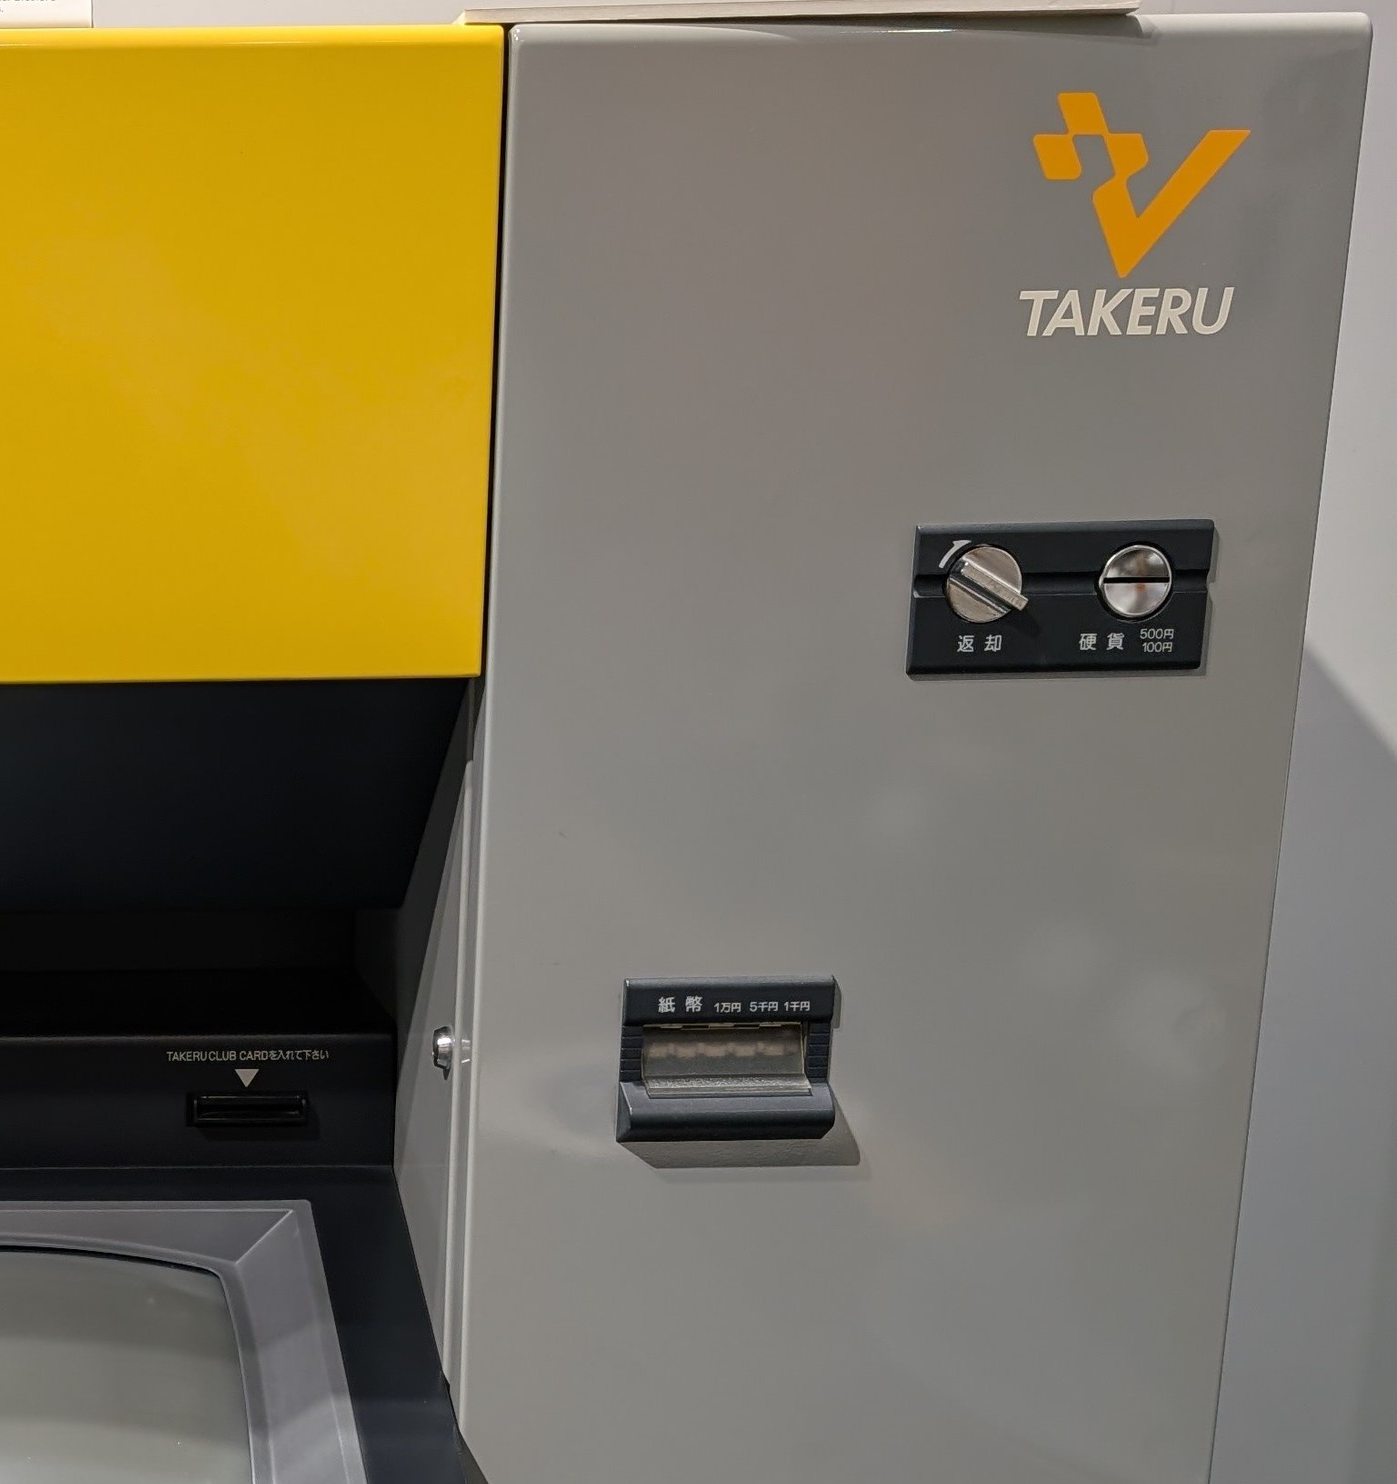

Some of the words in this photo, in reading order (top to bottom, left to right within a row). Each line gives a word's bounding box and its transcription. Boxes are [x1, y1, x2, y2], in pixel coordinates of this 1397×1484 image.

[1019, 286, 1235, 336] TAKERU
[1139, 628, 1175, 640] 500円
[1141, 641, 1173, 654] 100円
